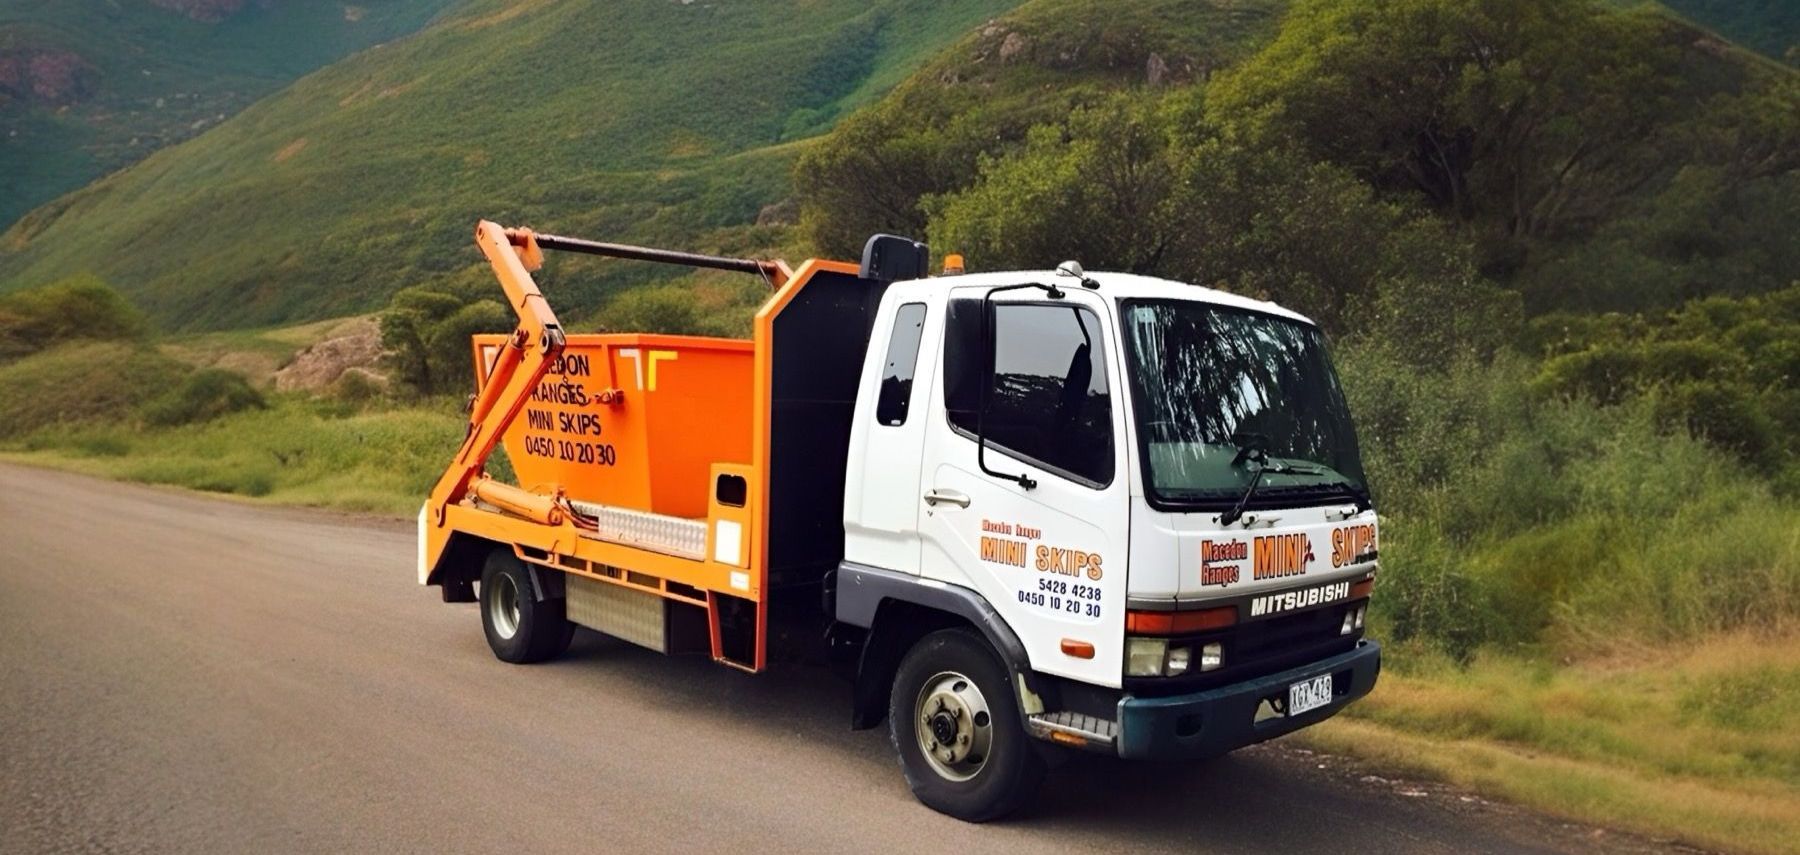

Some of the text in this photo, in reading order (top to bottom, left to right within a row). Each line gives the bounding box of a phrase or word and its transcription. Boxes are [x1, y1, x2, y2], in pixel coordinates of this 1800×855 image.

[527, 409, 601, 436] MINI SKIPS
[525, 435, 616, 466] 0450 10 20 30
[980, 536, 1103, 581] MINI SKIPS
[1201, 538, 1247, 562] Macedon
[1254, 523, 1376, 580] MINI SKIPS
[1039, 578, 1101, 601] 5428 4238
[1201, 564, 1239, 587] Ranges
[1018, 590, 1101, 618] 0450 10 20 30
[1251, 581, 1350, 617] MITSUBISHI
